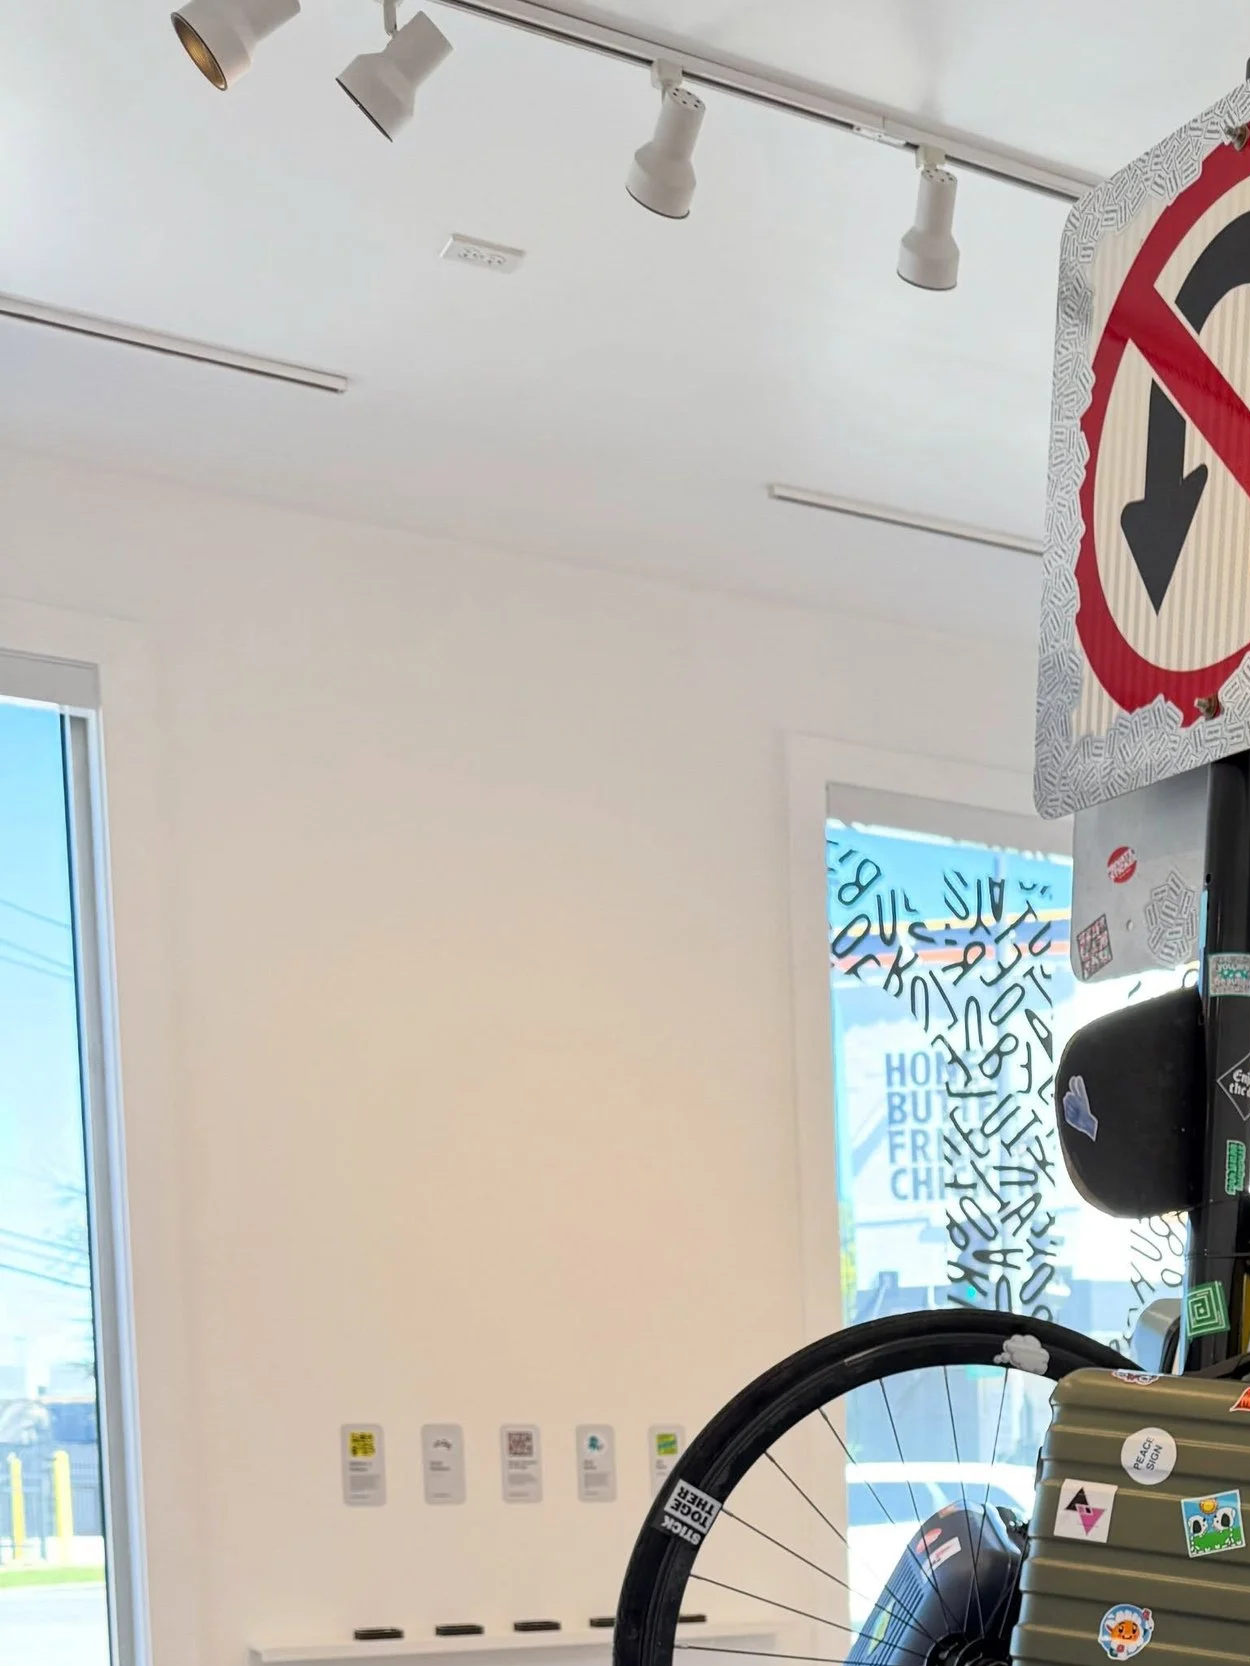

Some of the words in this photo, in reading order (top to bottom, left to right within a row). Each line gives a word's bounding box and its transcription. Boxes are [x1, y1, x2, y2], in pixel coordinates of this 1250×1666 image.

[1133, 1436, 1154, 1471] PEACE
[1146, 1445, 1163, 1471] SIGN
[670, 1498, 708, 1528] TOGE
[677, 1486, 714, 1516] THER
[661, 1515, 701, 1545] STICK
